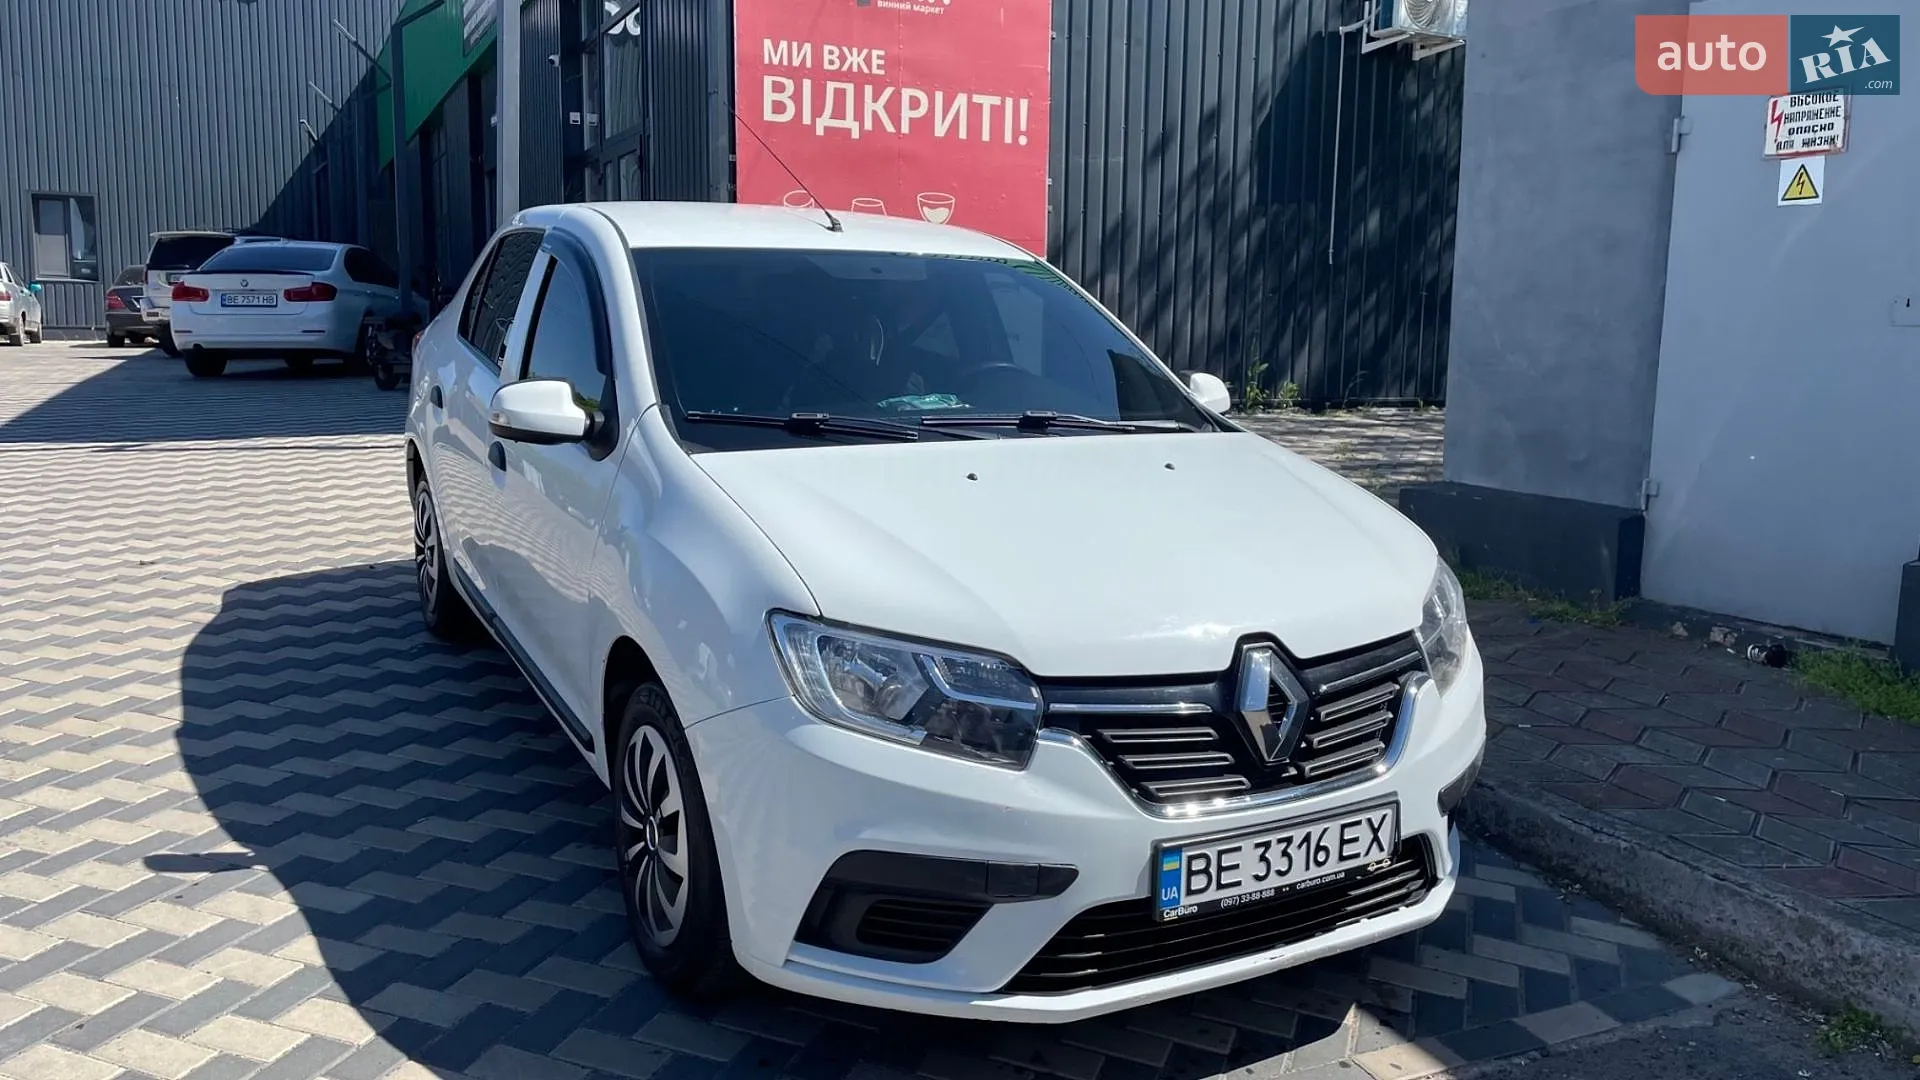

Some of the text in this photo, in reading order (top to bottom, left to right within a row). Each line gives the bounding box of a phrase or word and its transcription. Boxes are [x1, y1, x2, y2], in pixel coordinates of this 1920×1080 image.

[913, 4, 945, 15] маркет
[763, 38, 886, 76] МИ ВЖЕ
[1789, 90, 1839, 108] ВЫСОКОЕ
[763, 75, 1030, 147] ВІДКРИТІ!
[1784, 106, 1841, 124] НАПРЯЖЕНИЕ
[1788, 122, 1834, 136] ОПАСНО
[1776, 134, 1840, 151] ДЛЯ ЖИЗНИ!
[1185, 812, 1389, 896] BE 3316 EX
[1161, 886, 1179, 901] UA
